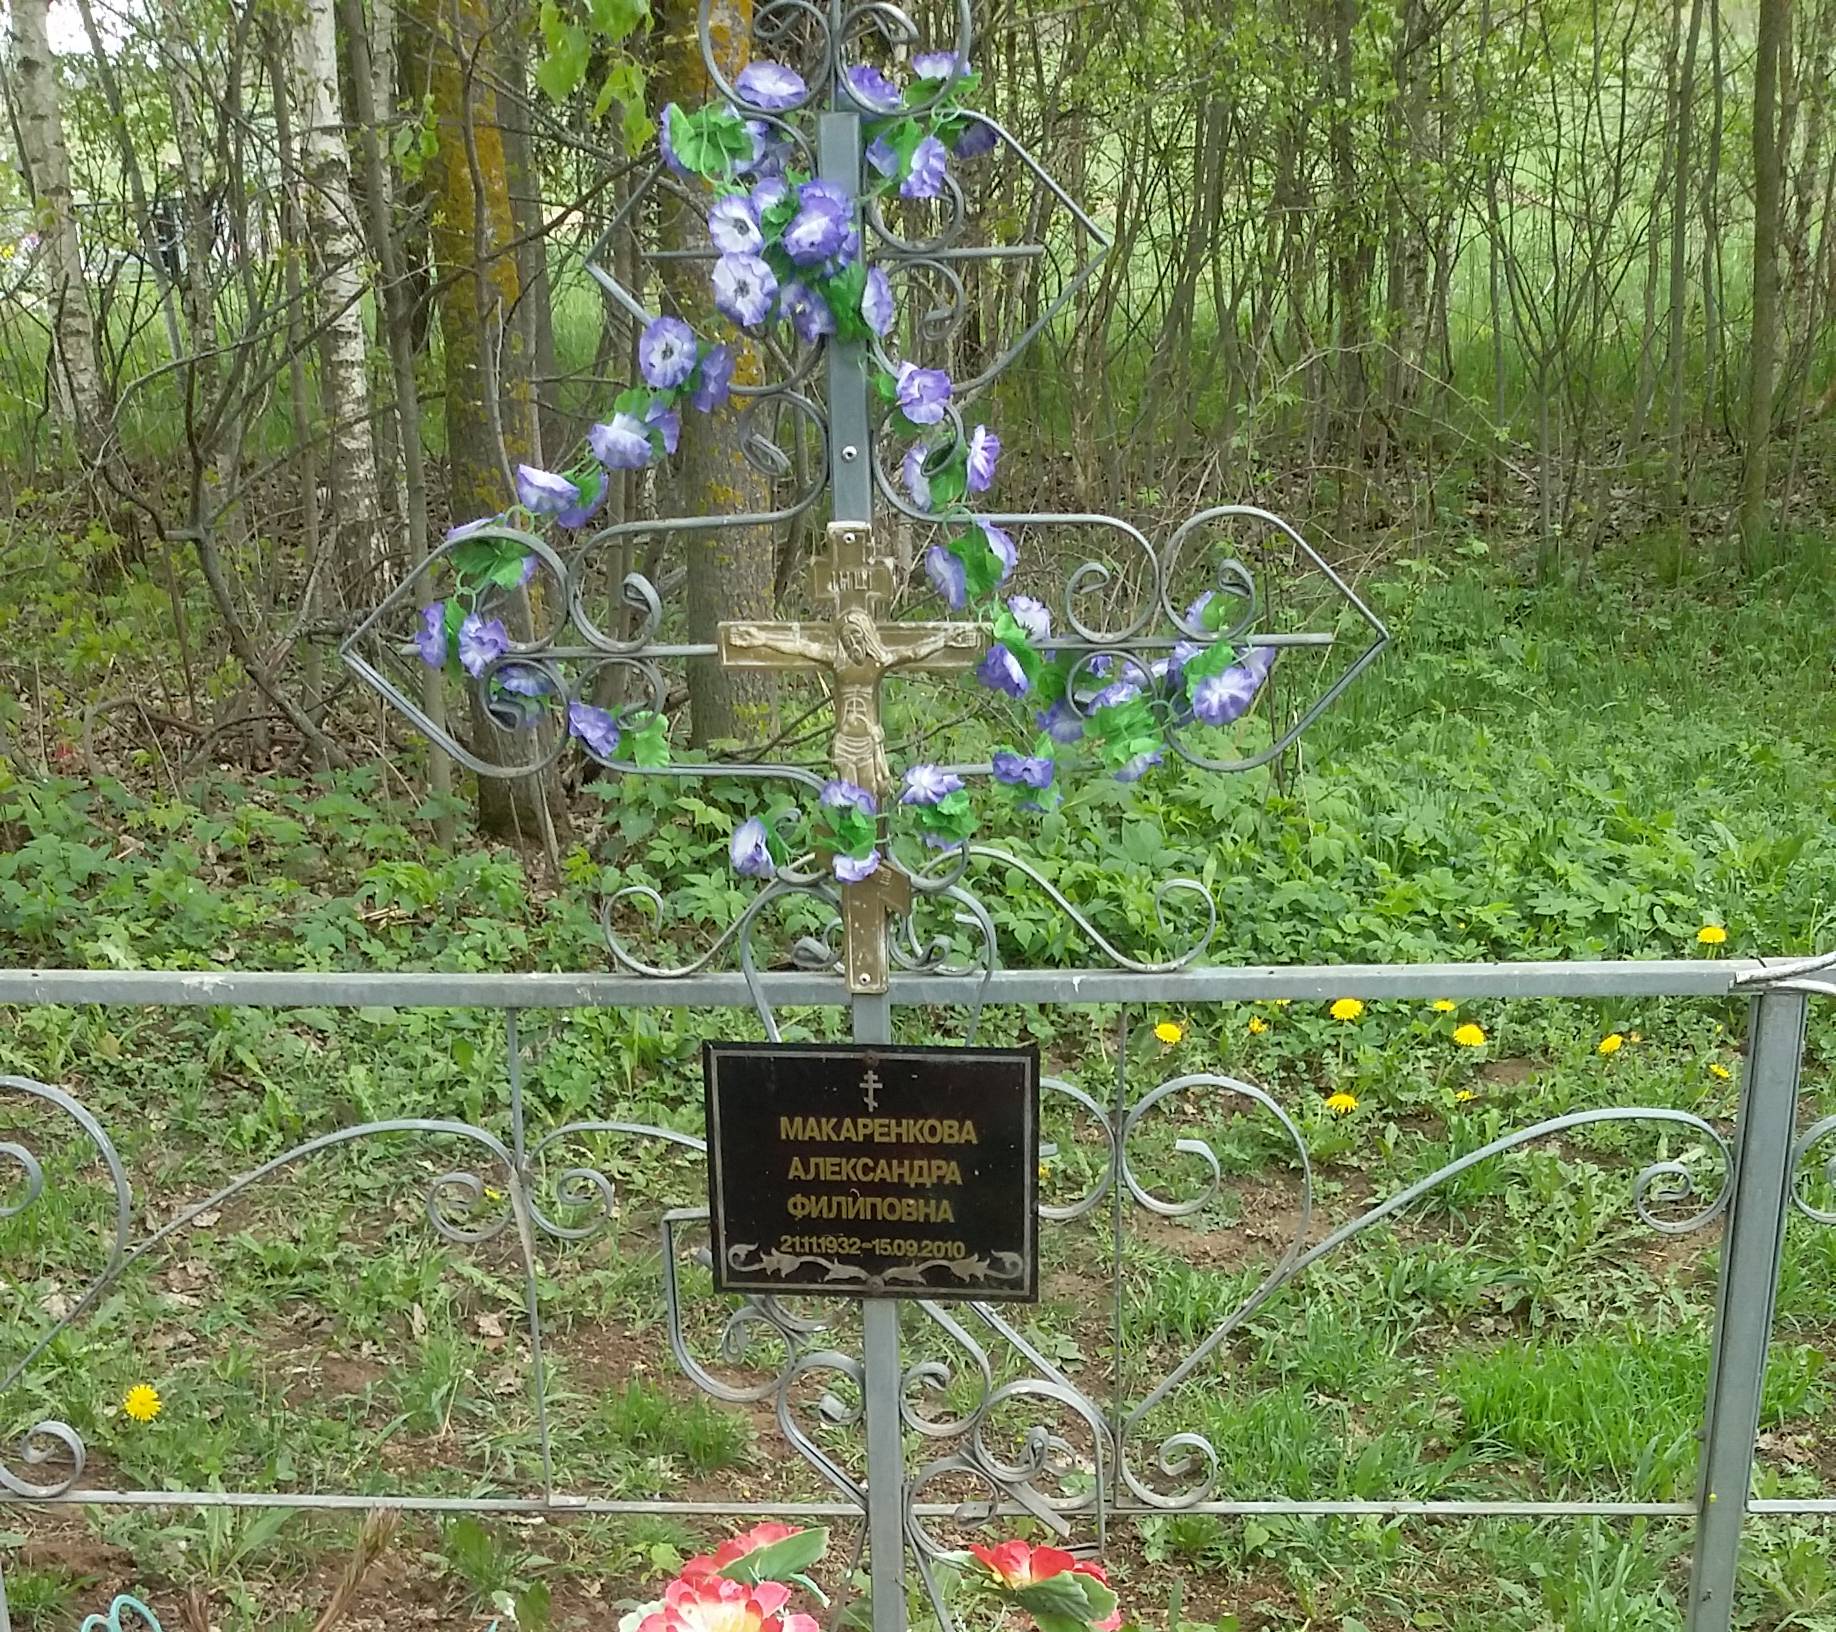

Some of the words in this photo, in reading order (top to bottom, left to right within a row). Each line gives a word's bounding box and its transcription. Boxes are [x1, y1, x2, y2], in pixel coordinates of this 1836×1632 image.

[780, 1116, 978, 1144] МАКАРЕНКОВА
[787, 1156, 963, 1188] АЛЕКСАНДРА
[787, 1193, 955, 1223] ФИЛИПОВНА
